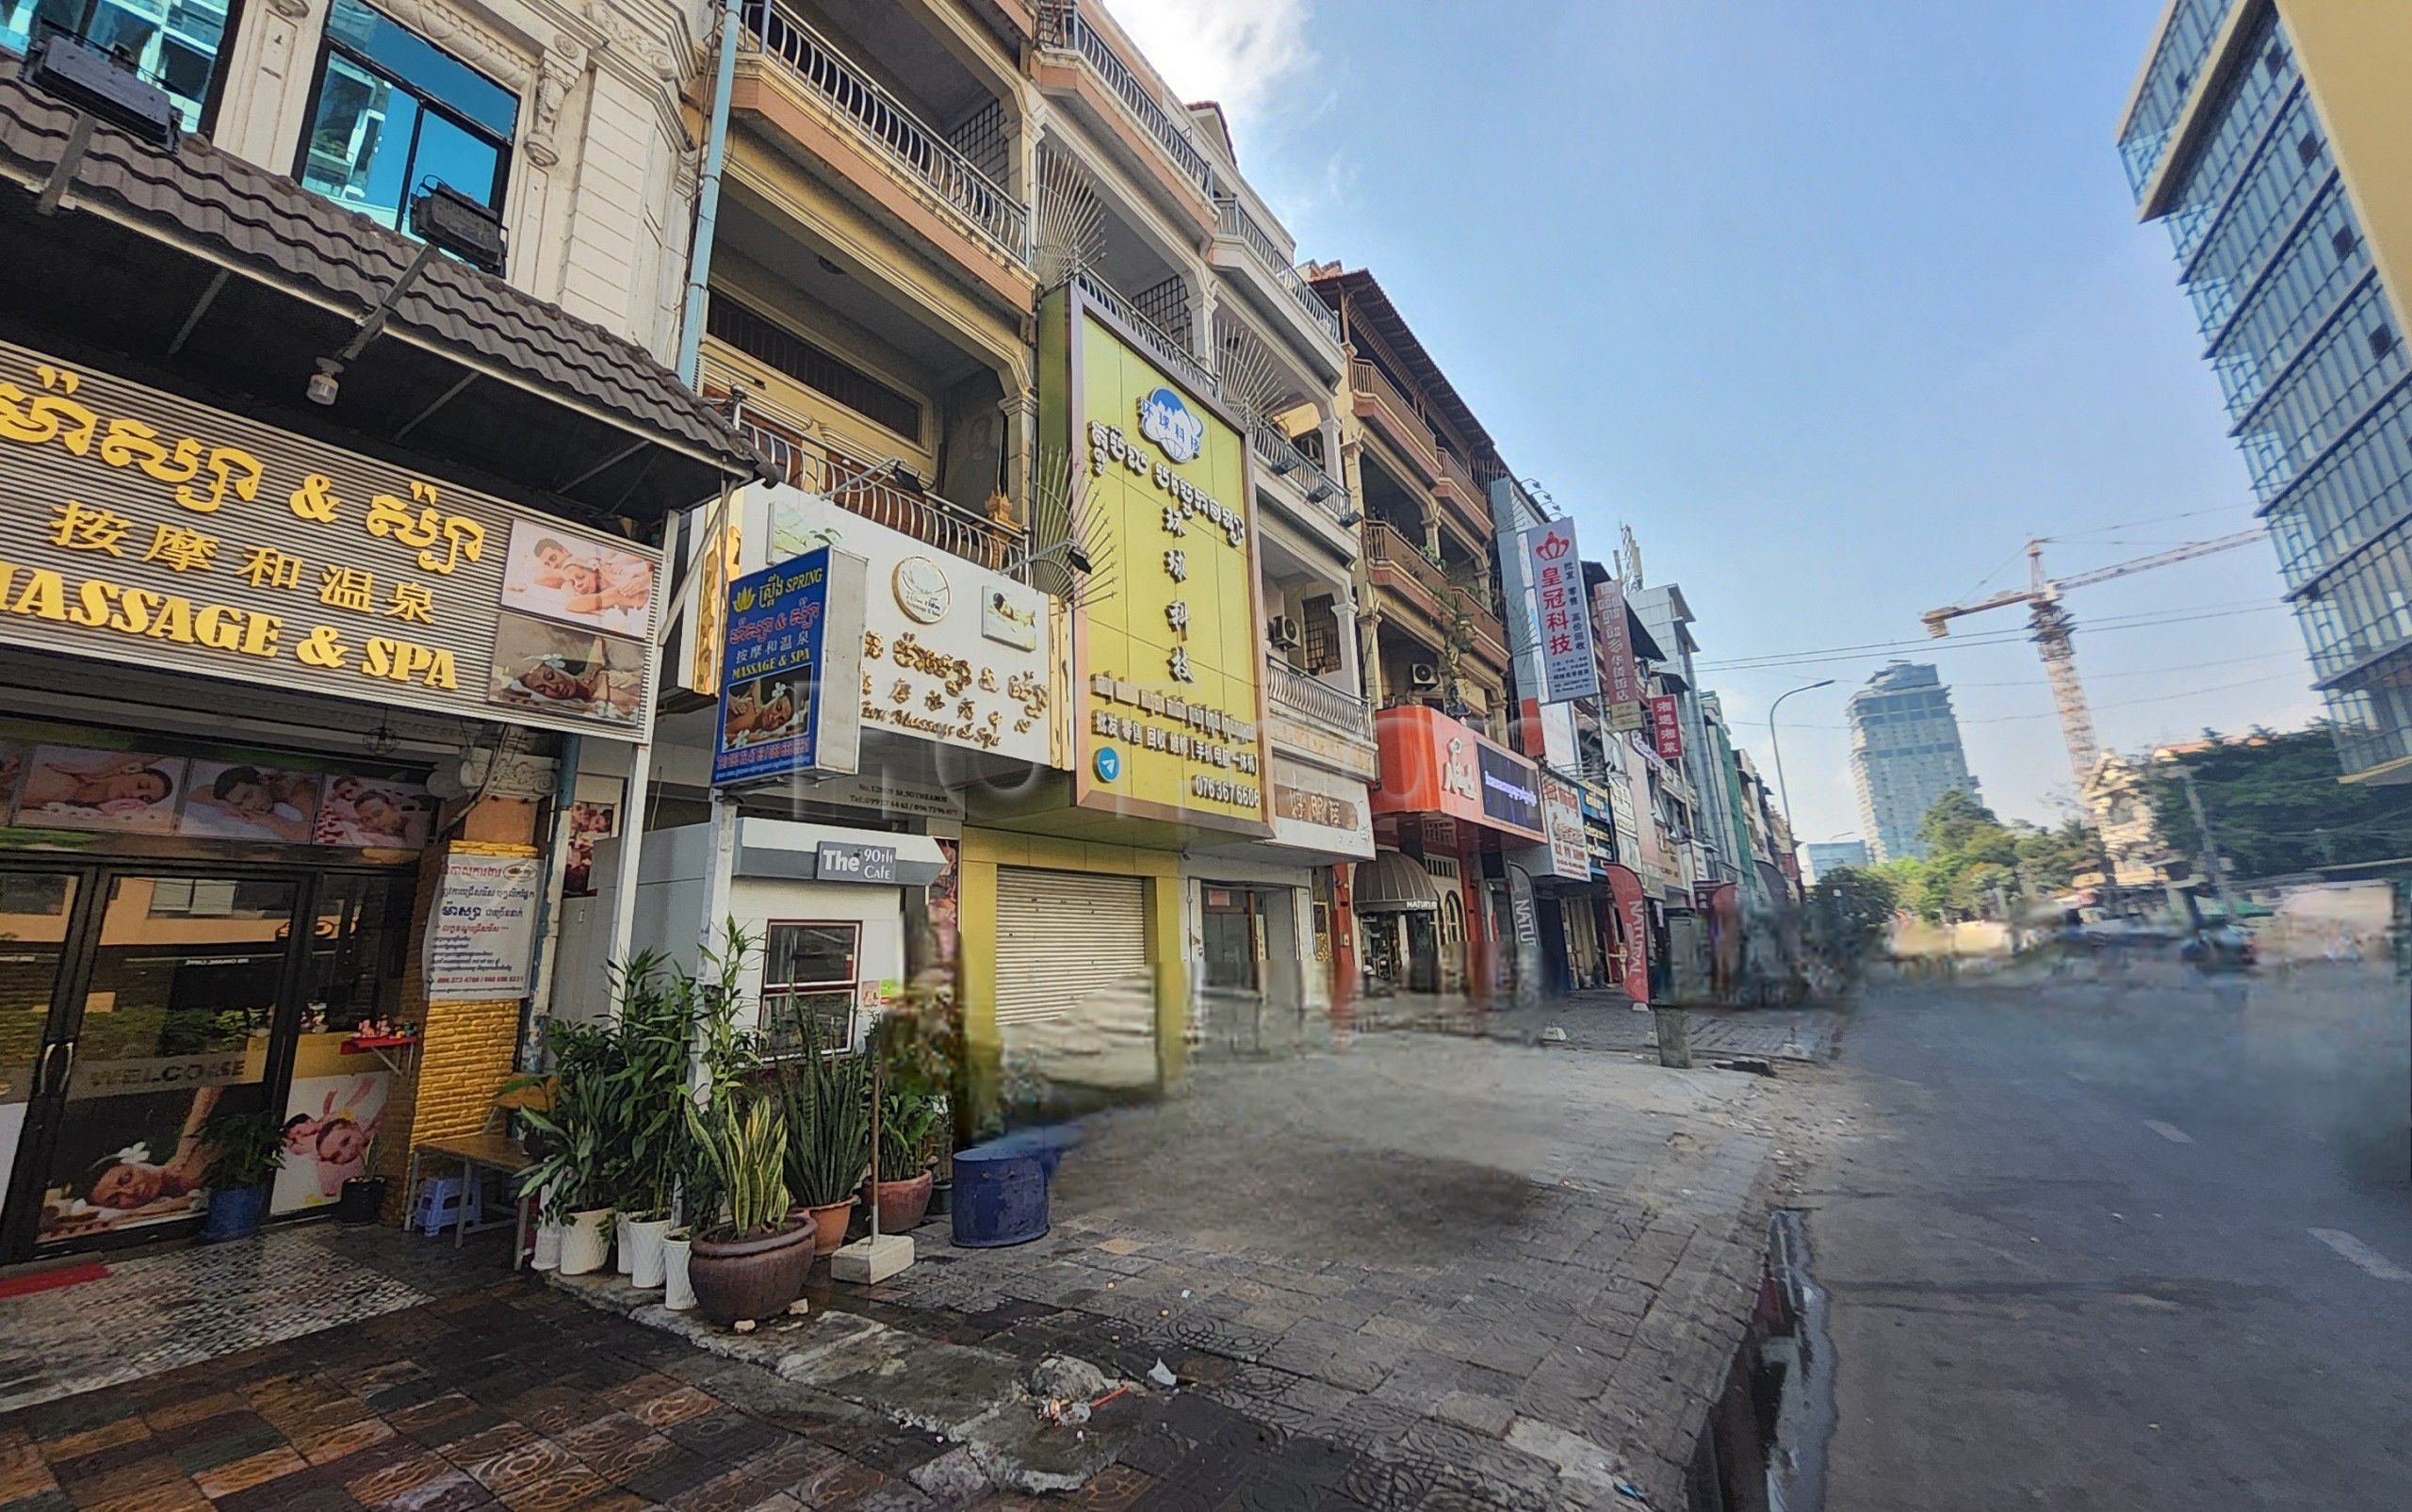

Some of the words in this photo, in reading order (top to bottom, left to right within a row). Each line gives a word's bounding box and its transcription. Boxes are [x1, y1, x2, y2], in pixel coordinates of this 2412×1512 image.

[290, 473, 342, 524] &
[48, 500, 437, 626] 按摩和温泉
[785, 567, 823, 595] SPRING
[1567, 586, 1578, 606] 零售
[775, 612, 787, 631] &
[1541, 566, 1573, 657] 皇冠科技
[0, 567, 284, 658] ASSAGE
[295, 626, 348, 669] &
[362, 637, 459, 690] SPA
[1572, 612, 1586, 651] 高价回收
[732, 656, 776, 680] MASSAGE
[778, 654, 788, 667] &
[790, 647, 811, 664] SPA
[736, 630, 809, 664] 按摩和温泉
[1147, 725, 1166, 751] 回收
[823, 849, 860, 872] The
[864, 848, 893, 864] 90th
